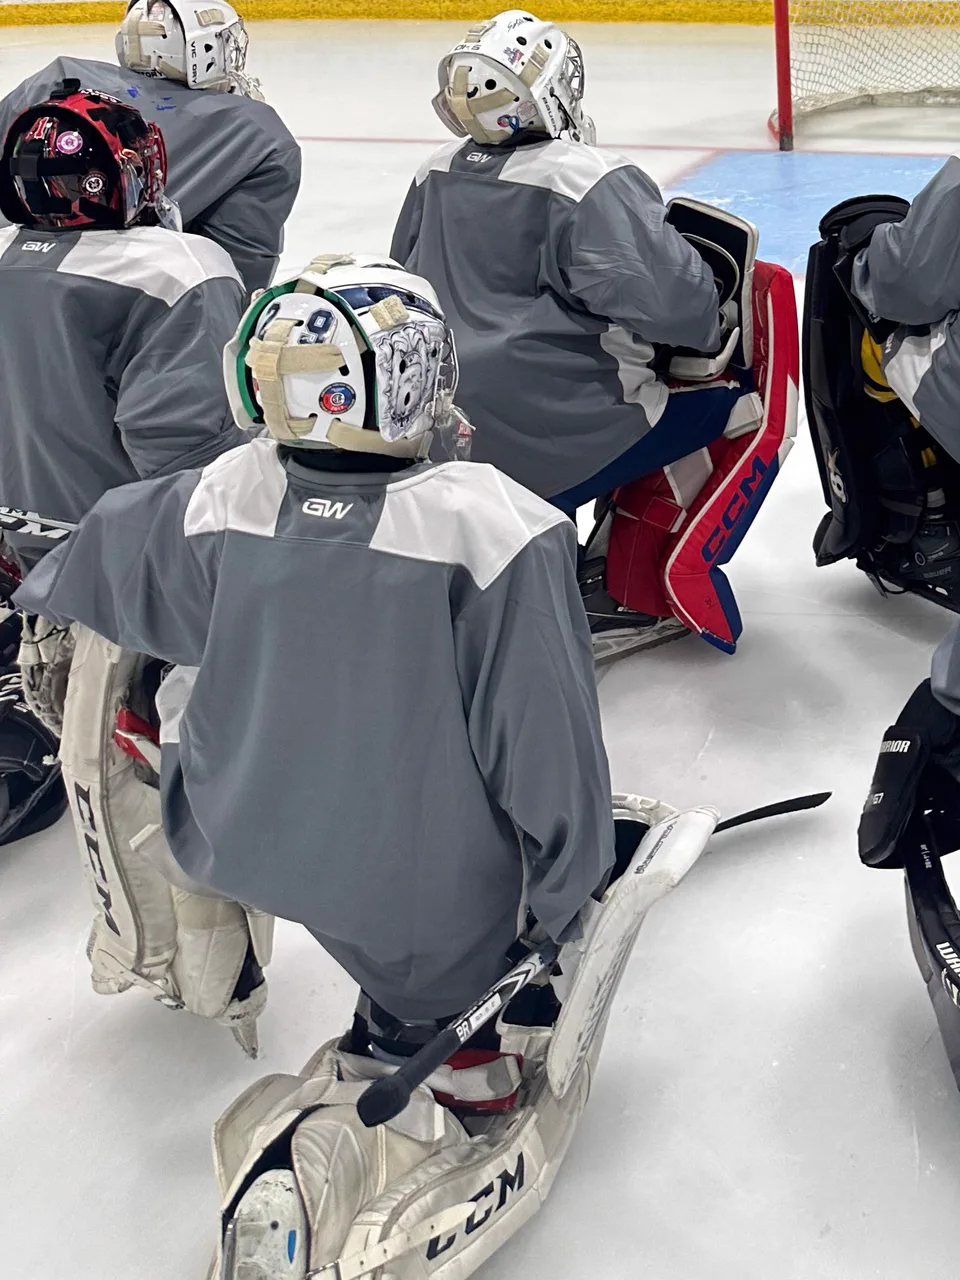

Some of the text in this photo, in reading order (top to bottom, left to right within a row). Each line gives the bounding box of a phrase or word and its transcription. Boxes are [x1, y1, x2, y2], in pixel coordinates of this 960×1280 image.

[466, 151, 493, 164] GW
[21, 240, 57, 254] GW
[302, 497, 354, 520] GW
[701, 454, 768, 563] CCM
[74, 780, 121, 938] CCM
